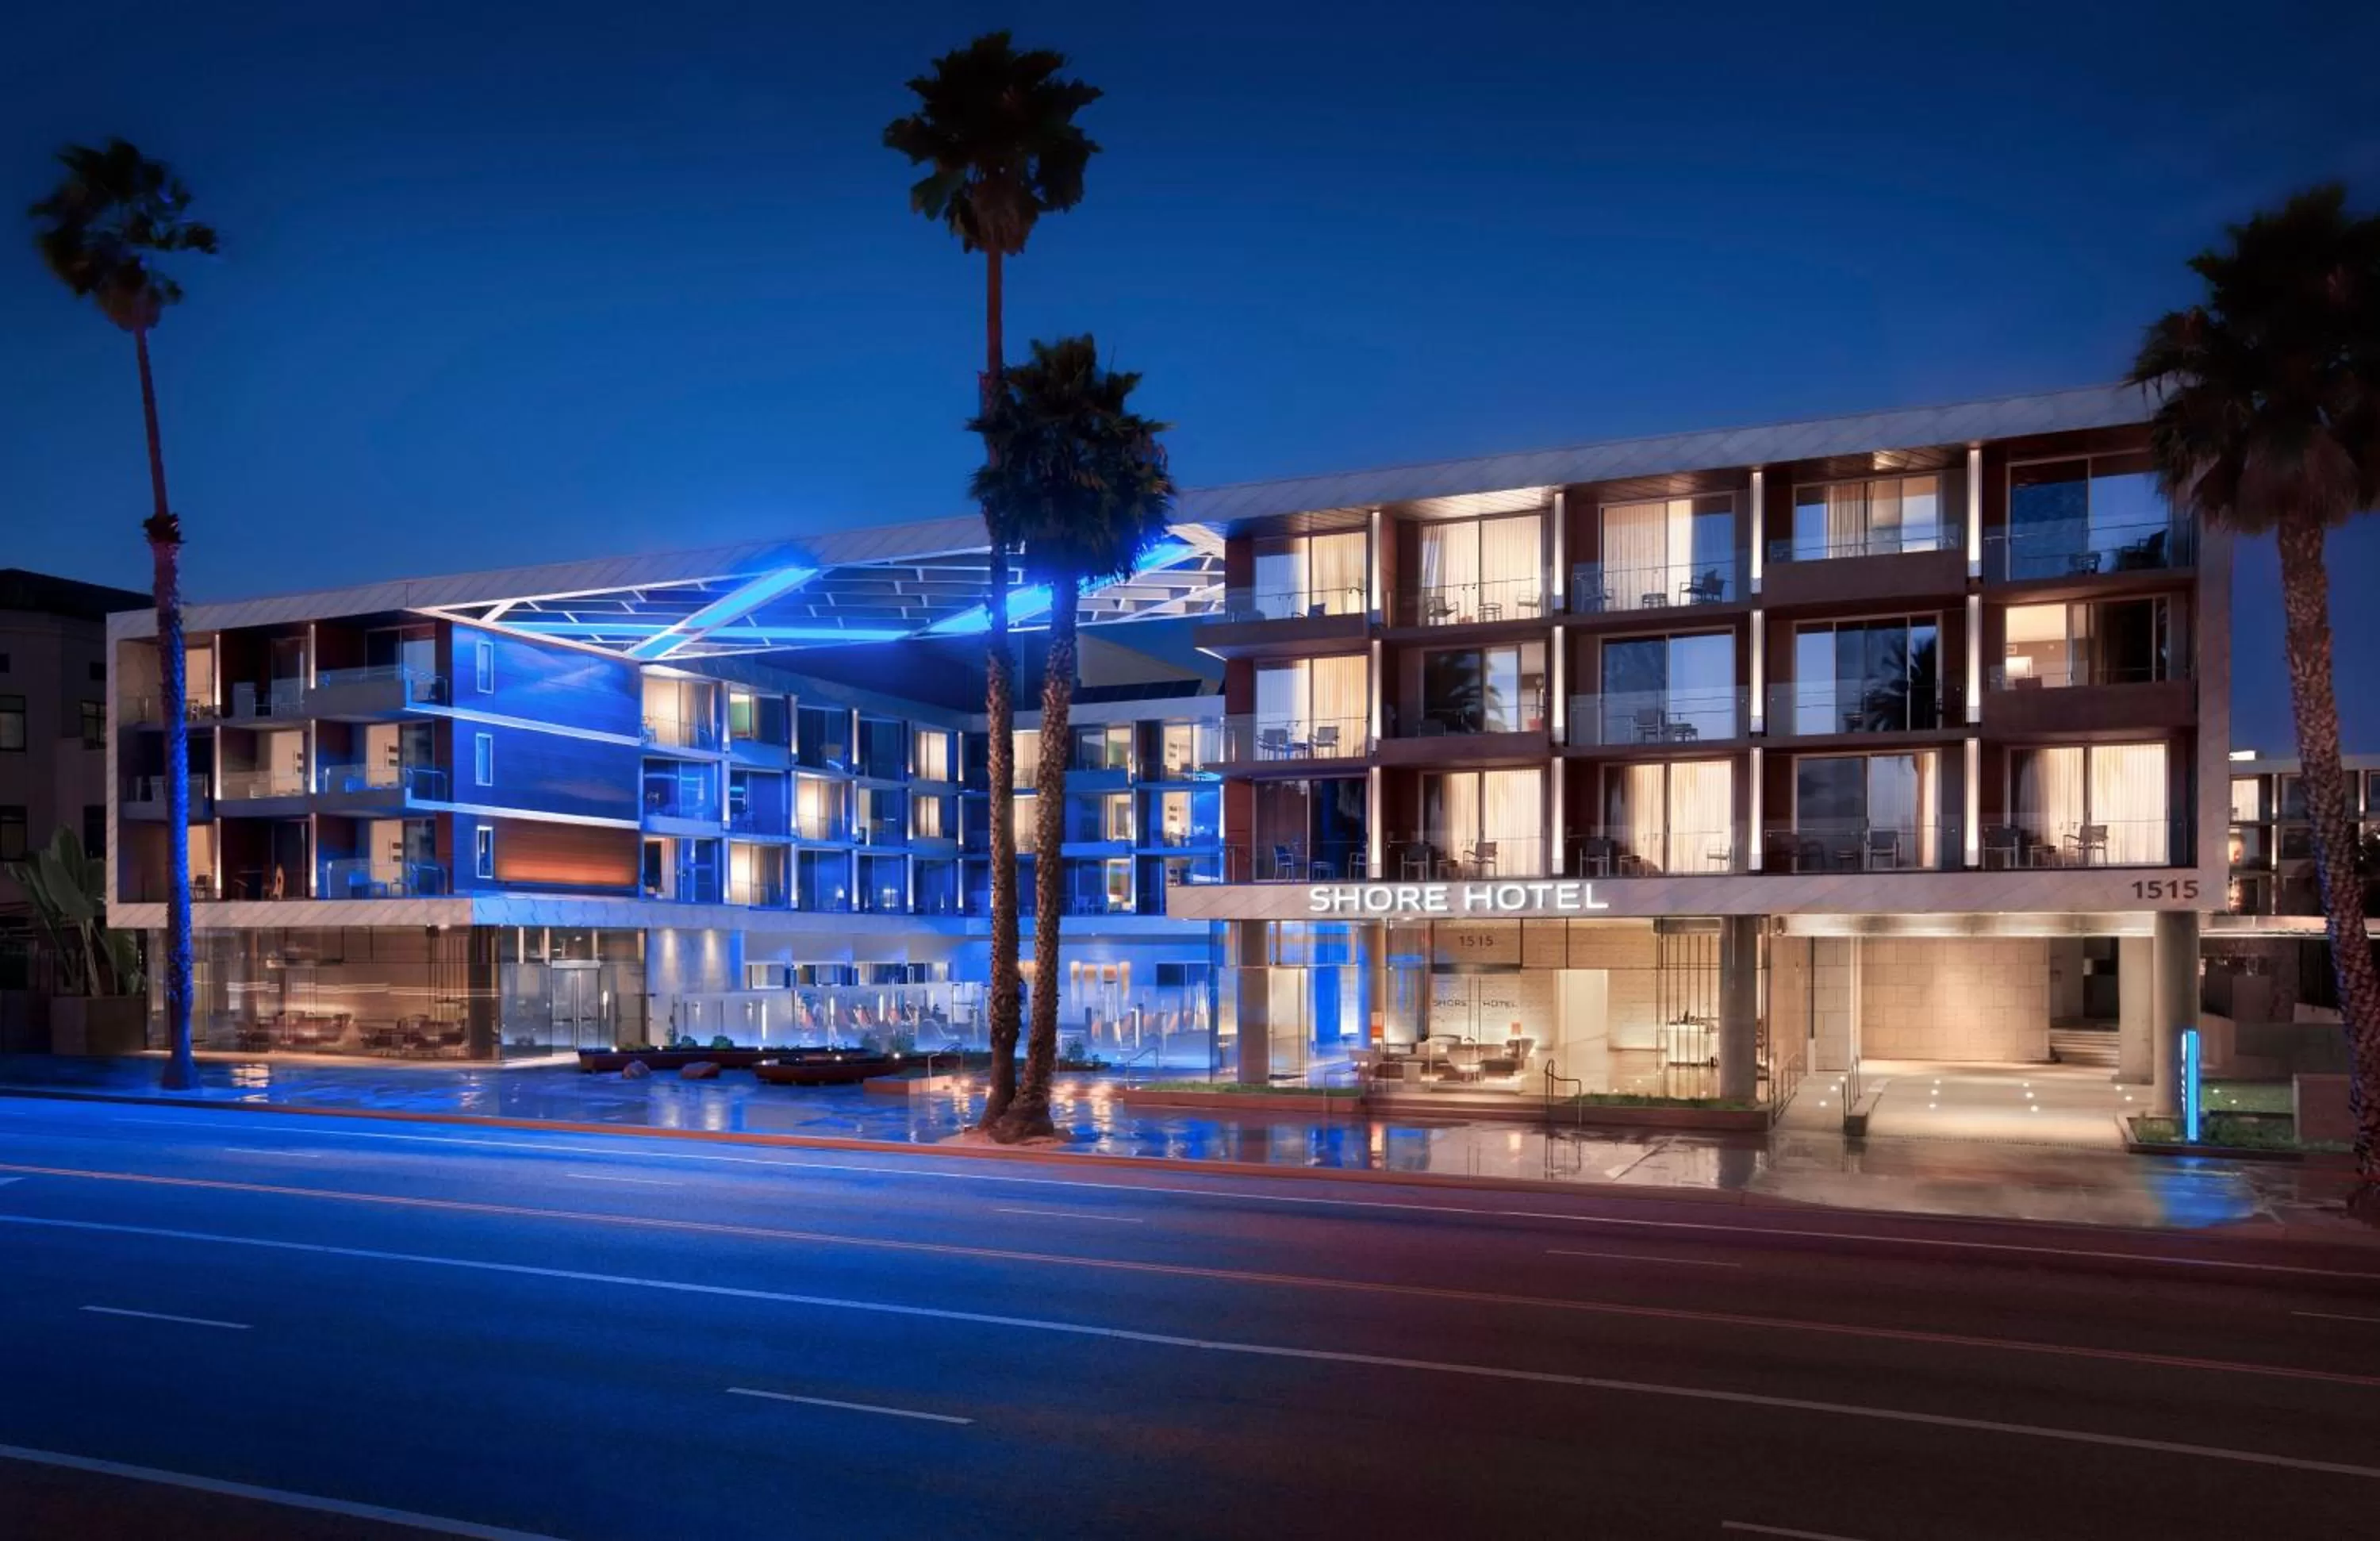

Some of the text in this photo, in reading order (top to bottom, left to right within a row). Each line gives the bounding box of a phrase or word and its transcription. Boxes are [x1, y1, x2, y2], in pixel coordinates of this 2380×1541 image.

[1308, 883, 1609, 912] SHORE HOTEL
[2132, 879, 2199, 899] 1515
[1459, 936, 1494, 947] 1515
